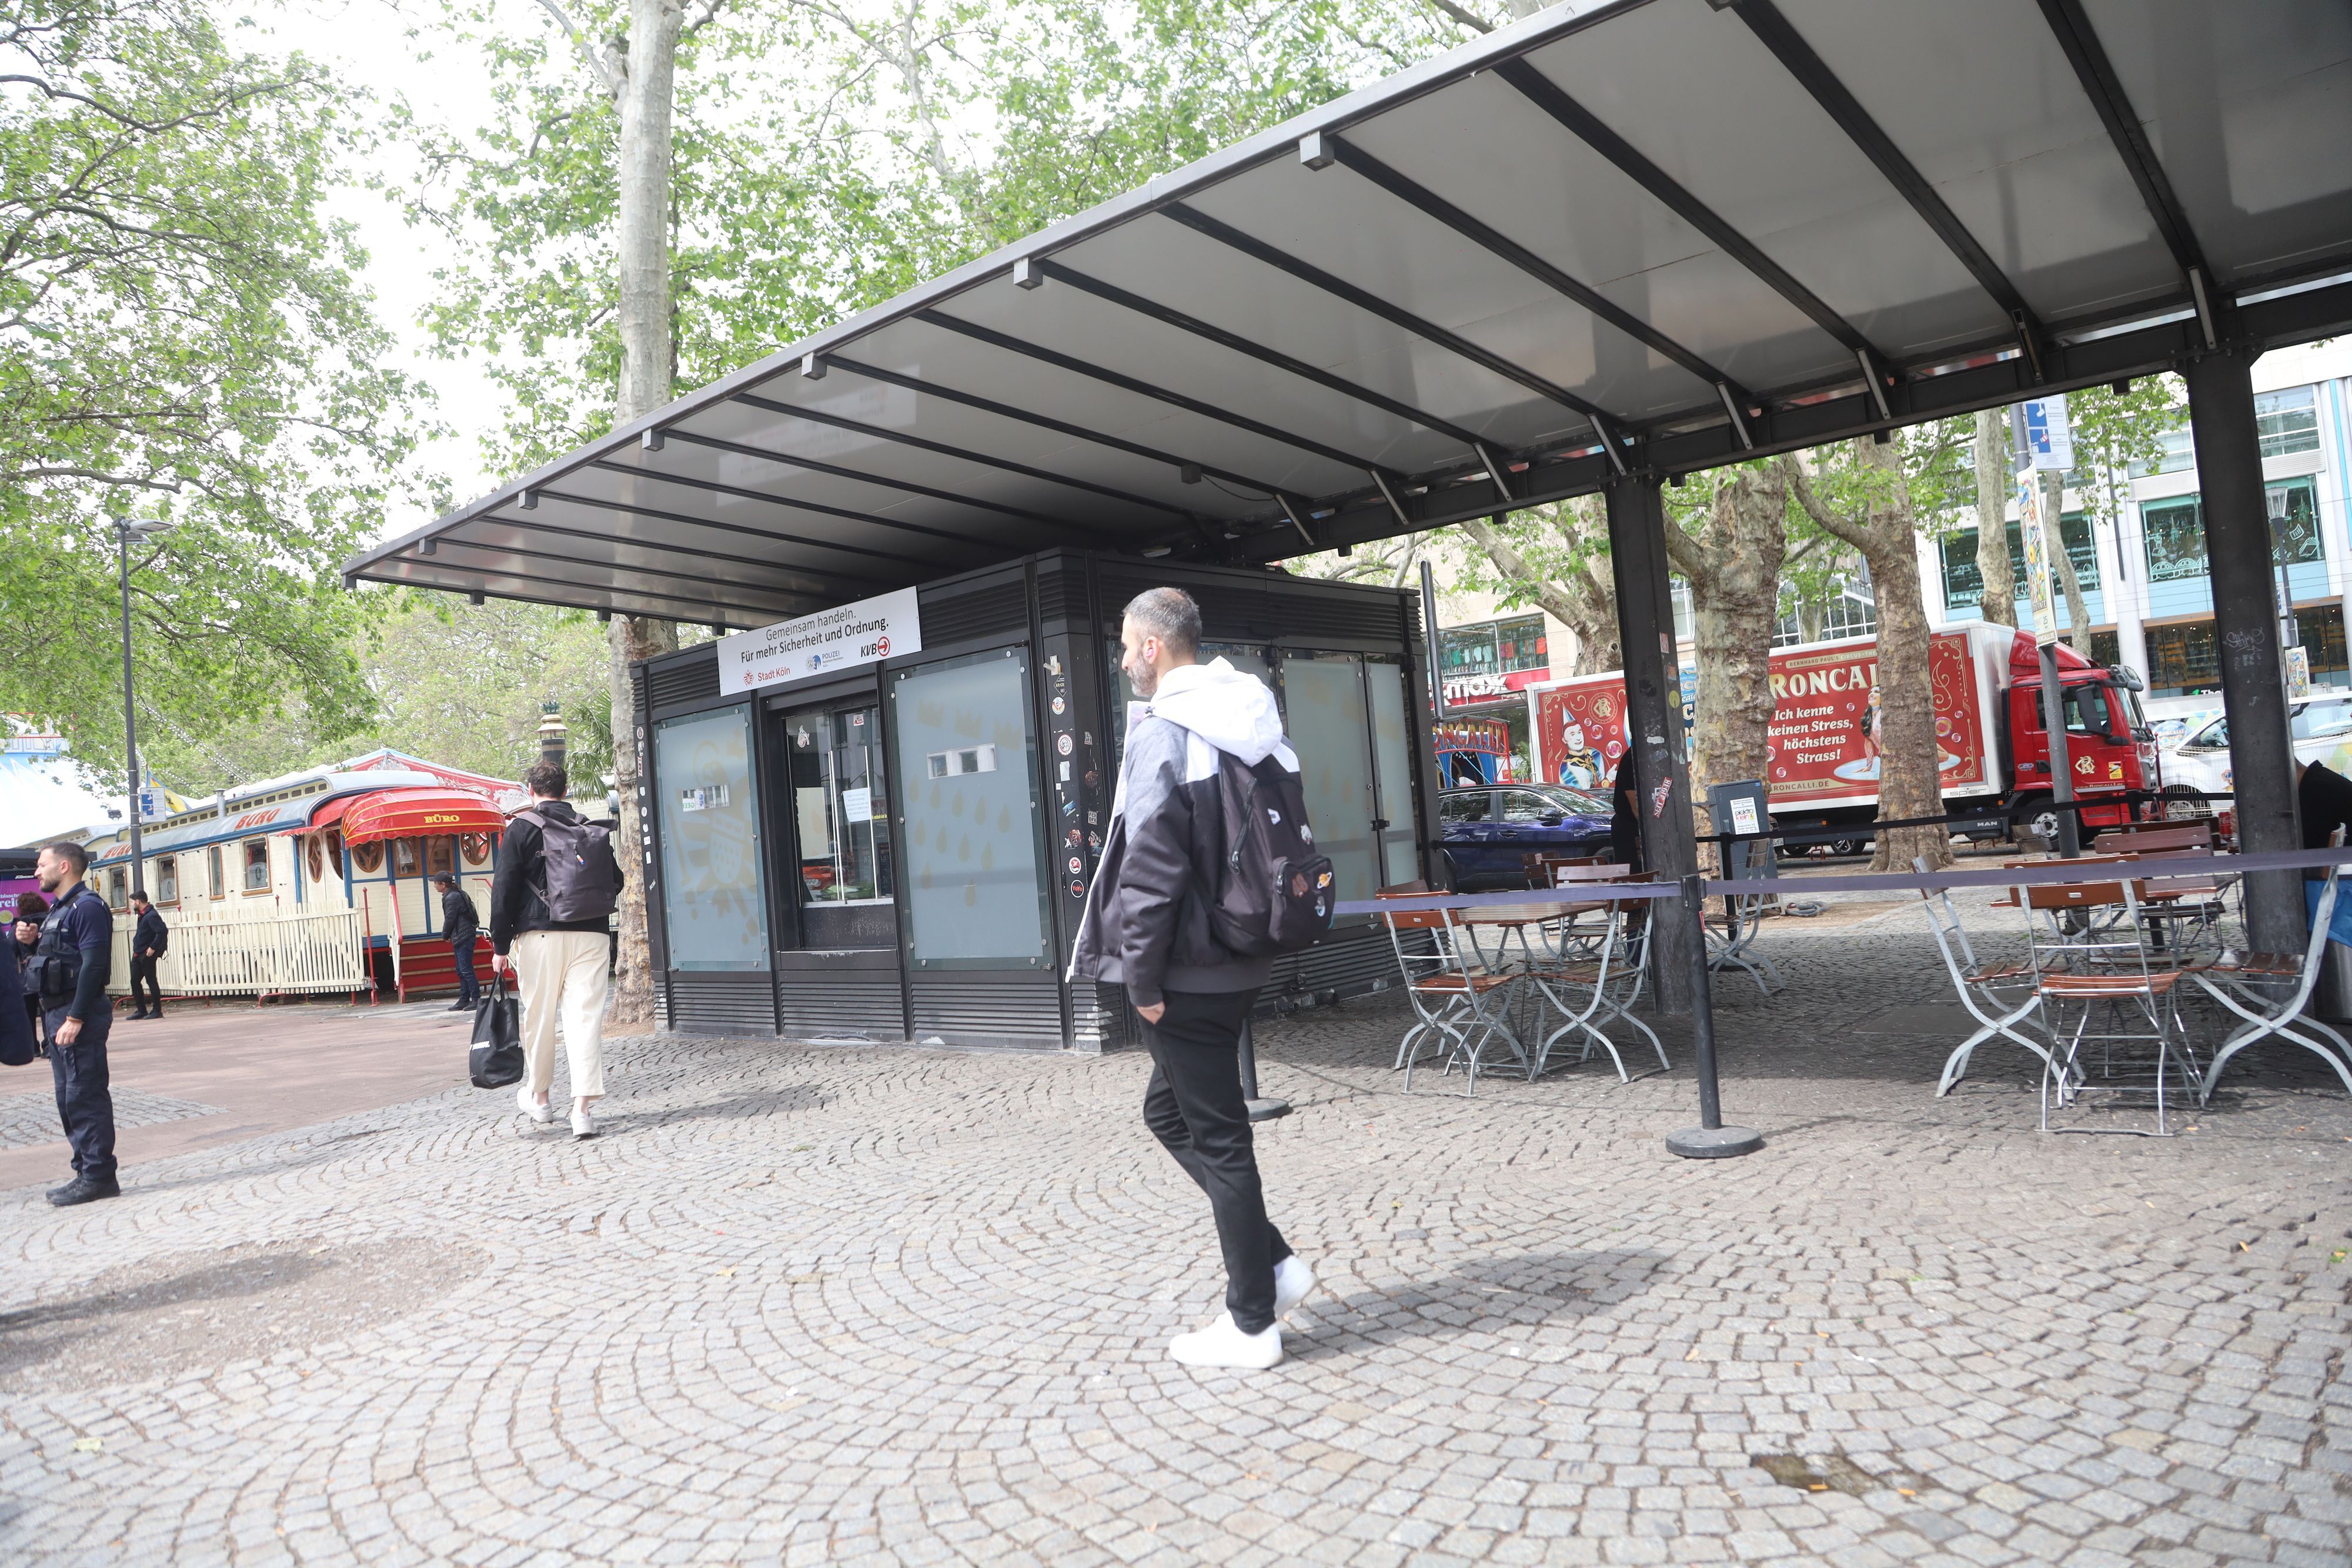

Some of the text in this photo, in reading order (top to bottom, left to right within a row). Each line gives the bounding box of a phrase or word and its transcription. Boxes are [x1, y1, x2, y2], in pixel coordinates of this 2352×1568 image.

[766, 607, 856, 641] Gemeinsam handeln.
[741, 618, 888, 663] Für mehr Sicherheit und Ordnung.
[823, 650, 840, 660] POLIZEI
[860, 643, 877, 657] KVB
[1790, 657, 1819, 667] BERNHARD
[757, 667, 791, 682] Stadt Köln
[1775, 706, 1834, 721] Ich kenne
[1768, 719, 1853, 737] keinen Stress,
[1783, 735, 1846, 750] höchstens
[1796, 748, 1841, 764] Strass!
[1950, 788, 1986, 797] spier
[423, 814, 460, 824] BÜRO
